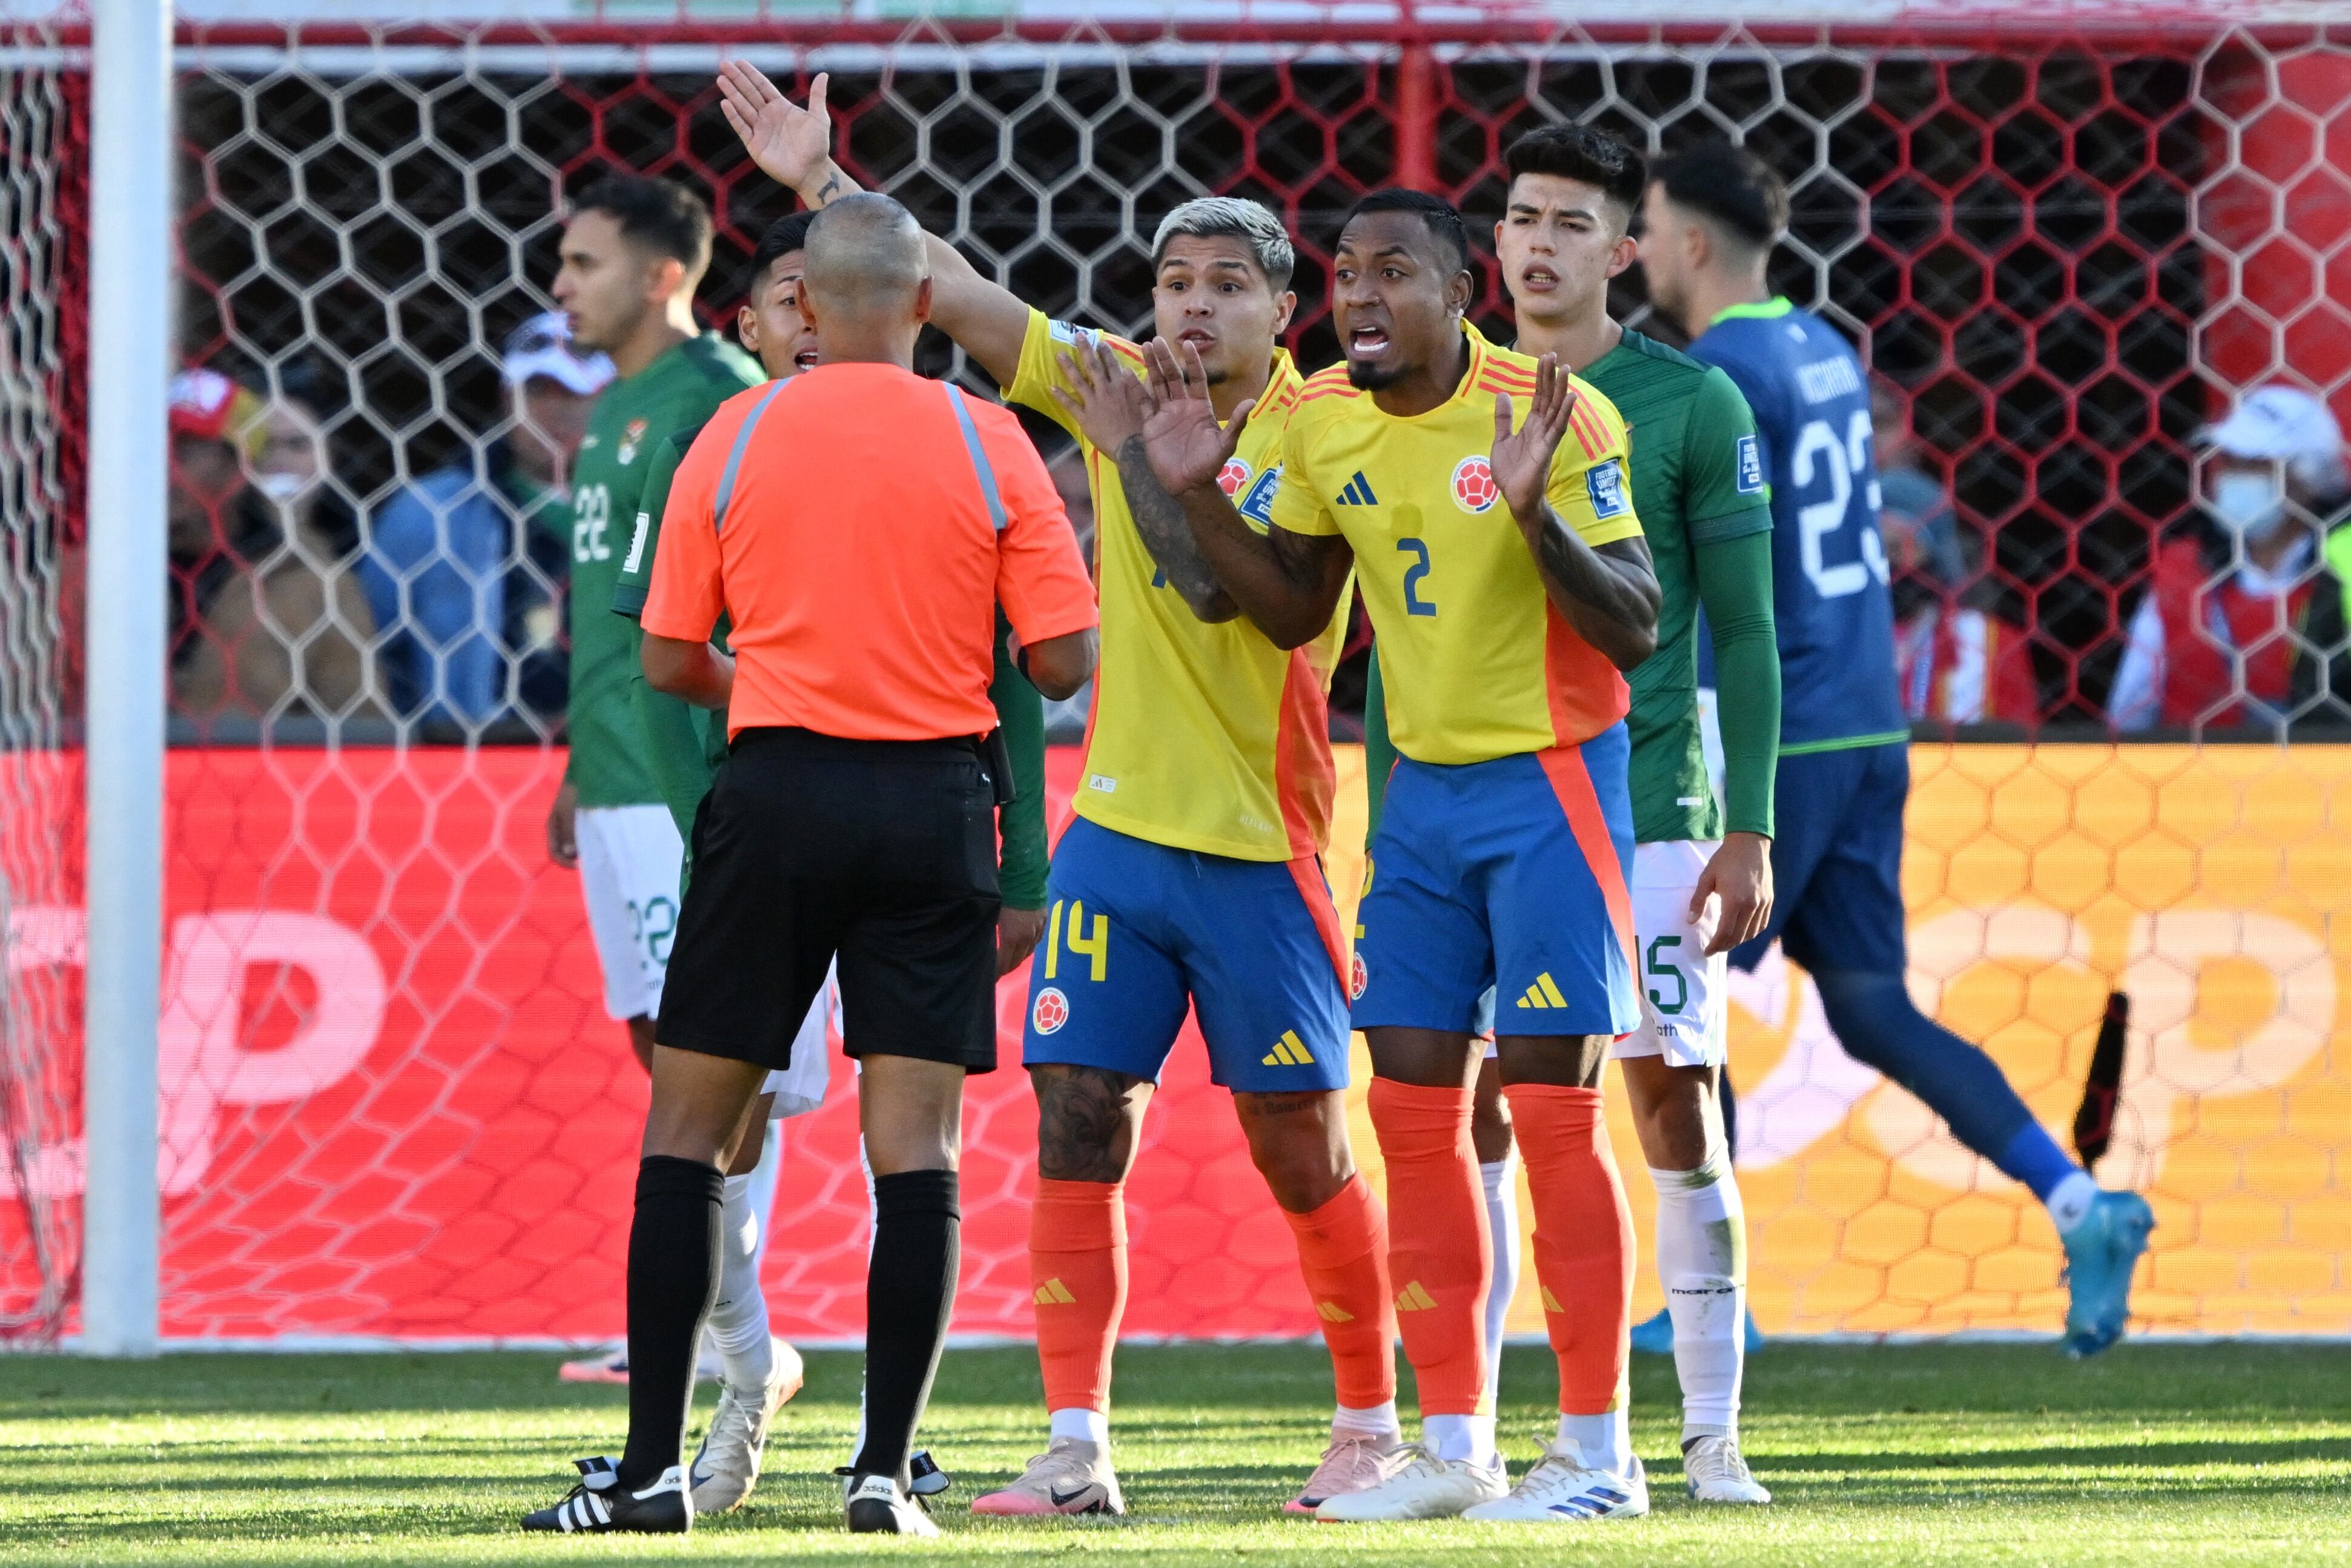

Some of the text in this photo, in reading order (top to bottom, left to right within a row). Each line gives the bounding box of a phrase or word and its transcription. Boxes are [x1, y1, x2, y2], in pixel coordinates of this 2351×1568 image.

[574, 483, 610, 561] 22
[1397, 537, 1437, 617] 2
[1045, 899, 1108, 981] 14
[863, 1484, 893, 1495] adida
